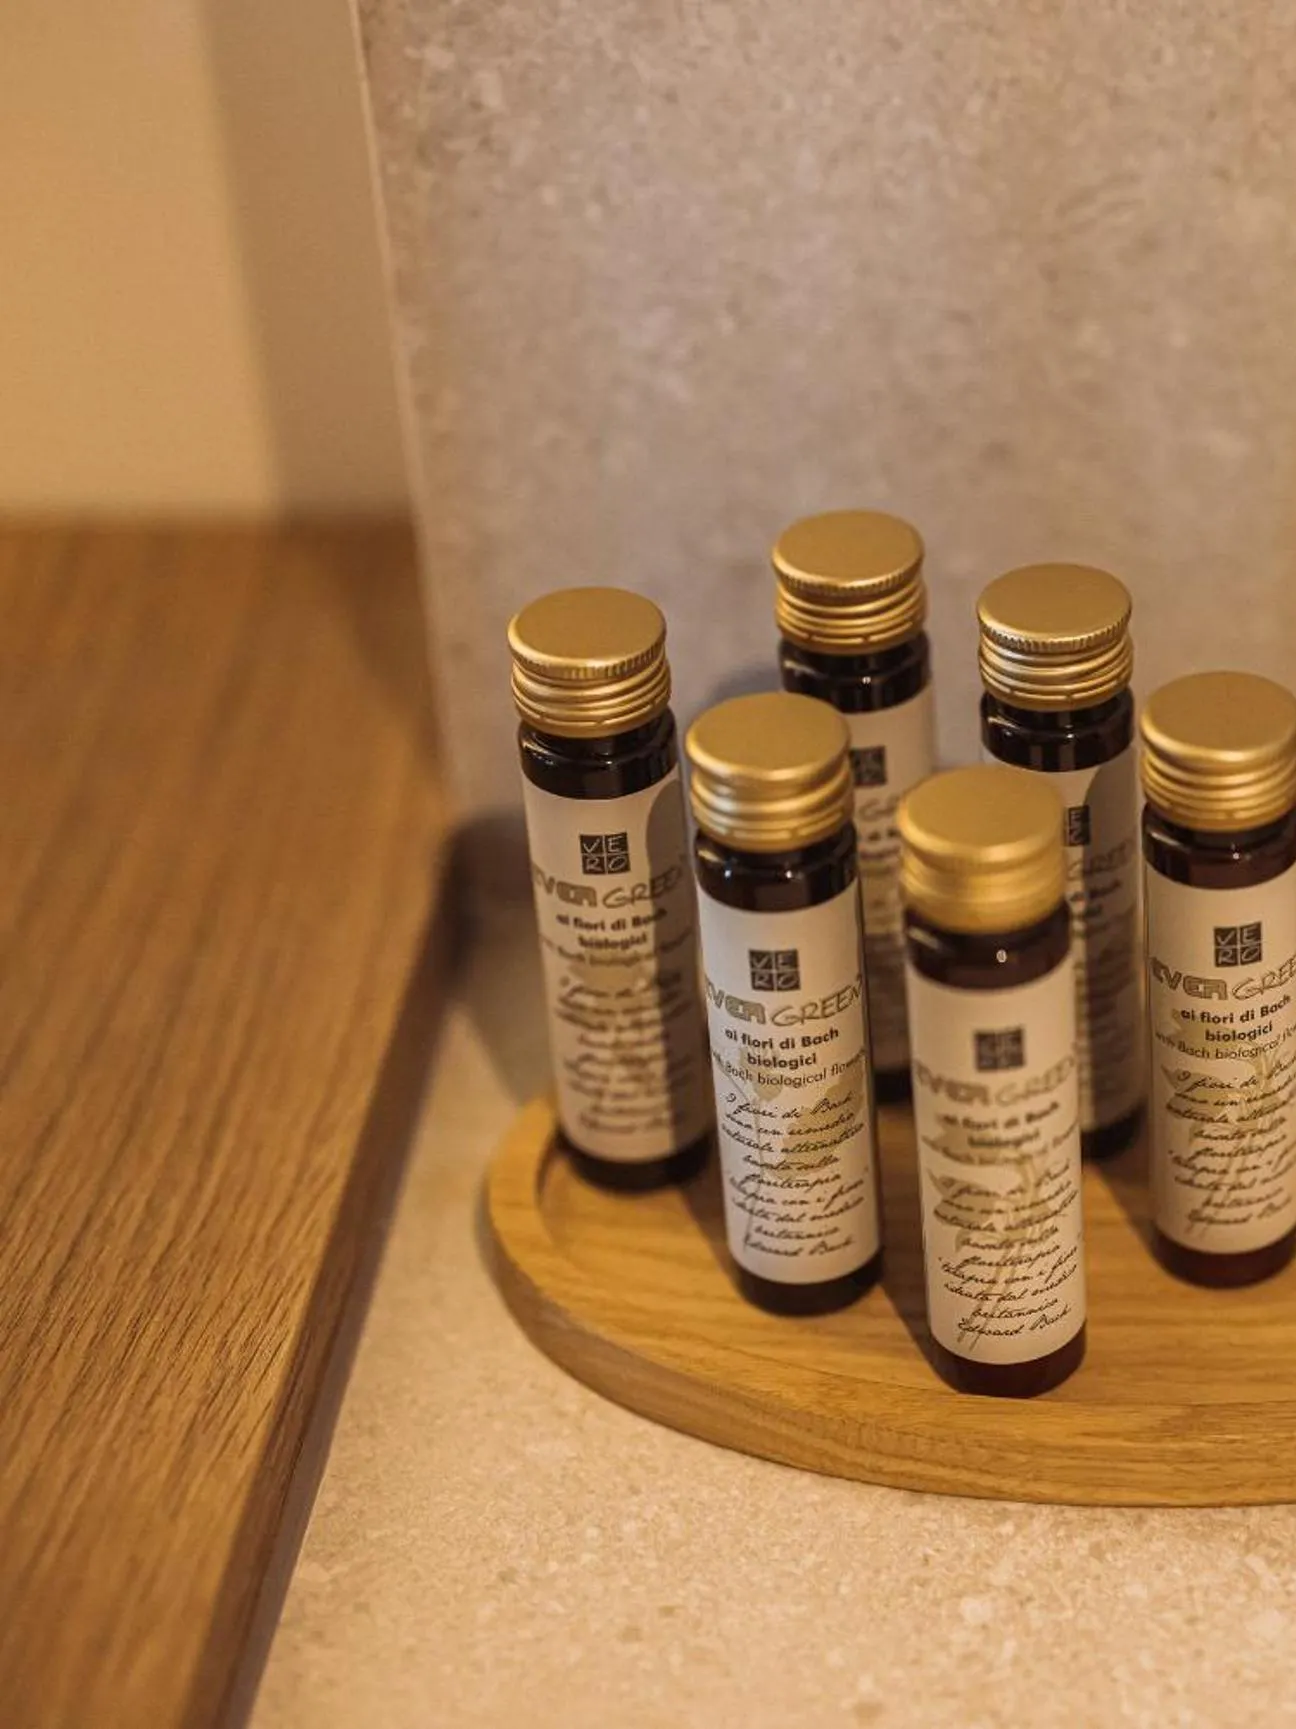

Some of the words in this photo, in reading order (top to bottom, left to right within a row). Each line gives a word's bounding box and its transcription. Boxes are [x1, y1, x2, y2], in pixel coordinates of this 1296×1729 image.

[573, 916, 605, 931] fiori
[611, 918, 626, 931] di
[578, 933, 647, 949] biologici
[1181, 1009, 1195, 1021] ai
[1200, 1010, 1233, 1024] fiori
[1240, 1010, 1255, 1023] di
[1260, 994, 1291, 1018] Bach
[725, 1029, 737, 1041] ai
[741, 1033, 773, 1049] fiori
[779, 1037, 795, 1050] di
[801, 1027, 839, 1047] Bach
[1204, 1020, 1272, 1042] biologici
[1177, 1040, 1210, 1059] Bach
[747, 1052, 816, 1070] biologici
[757, 1067, 826, 1089] biological
